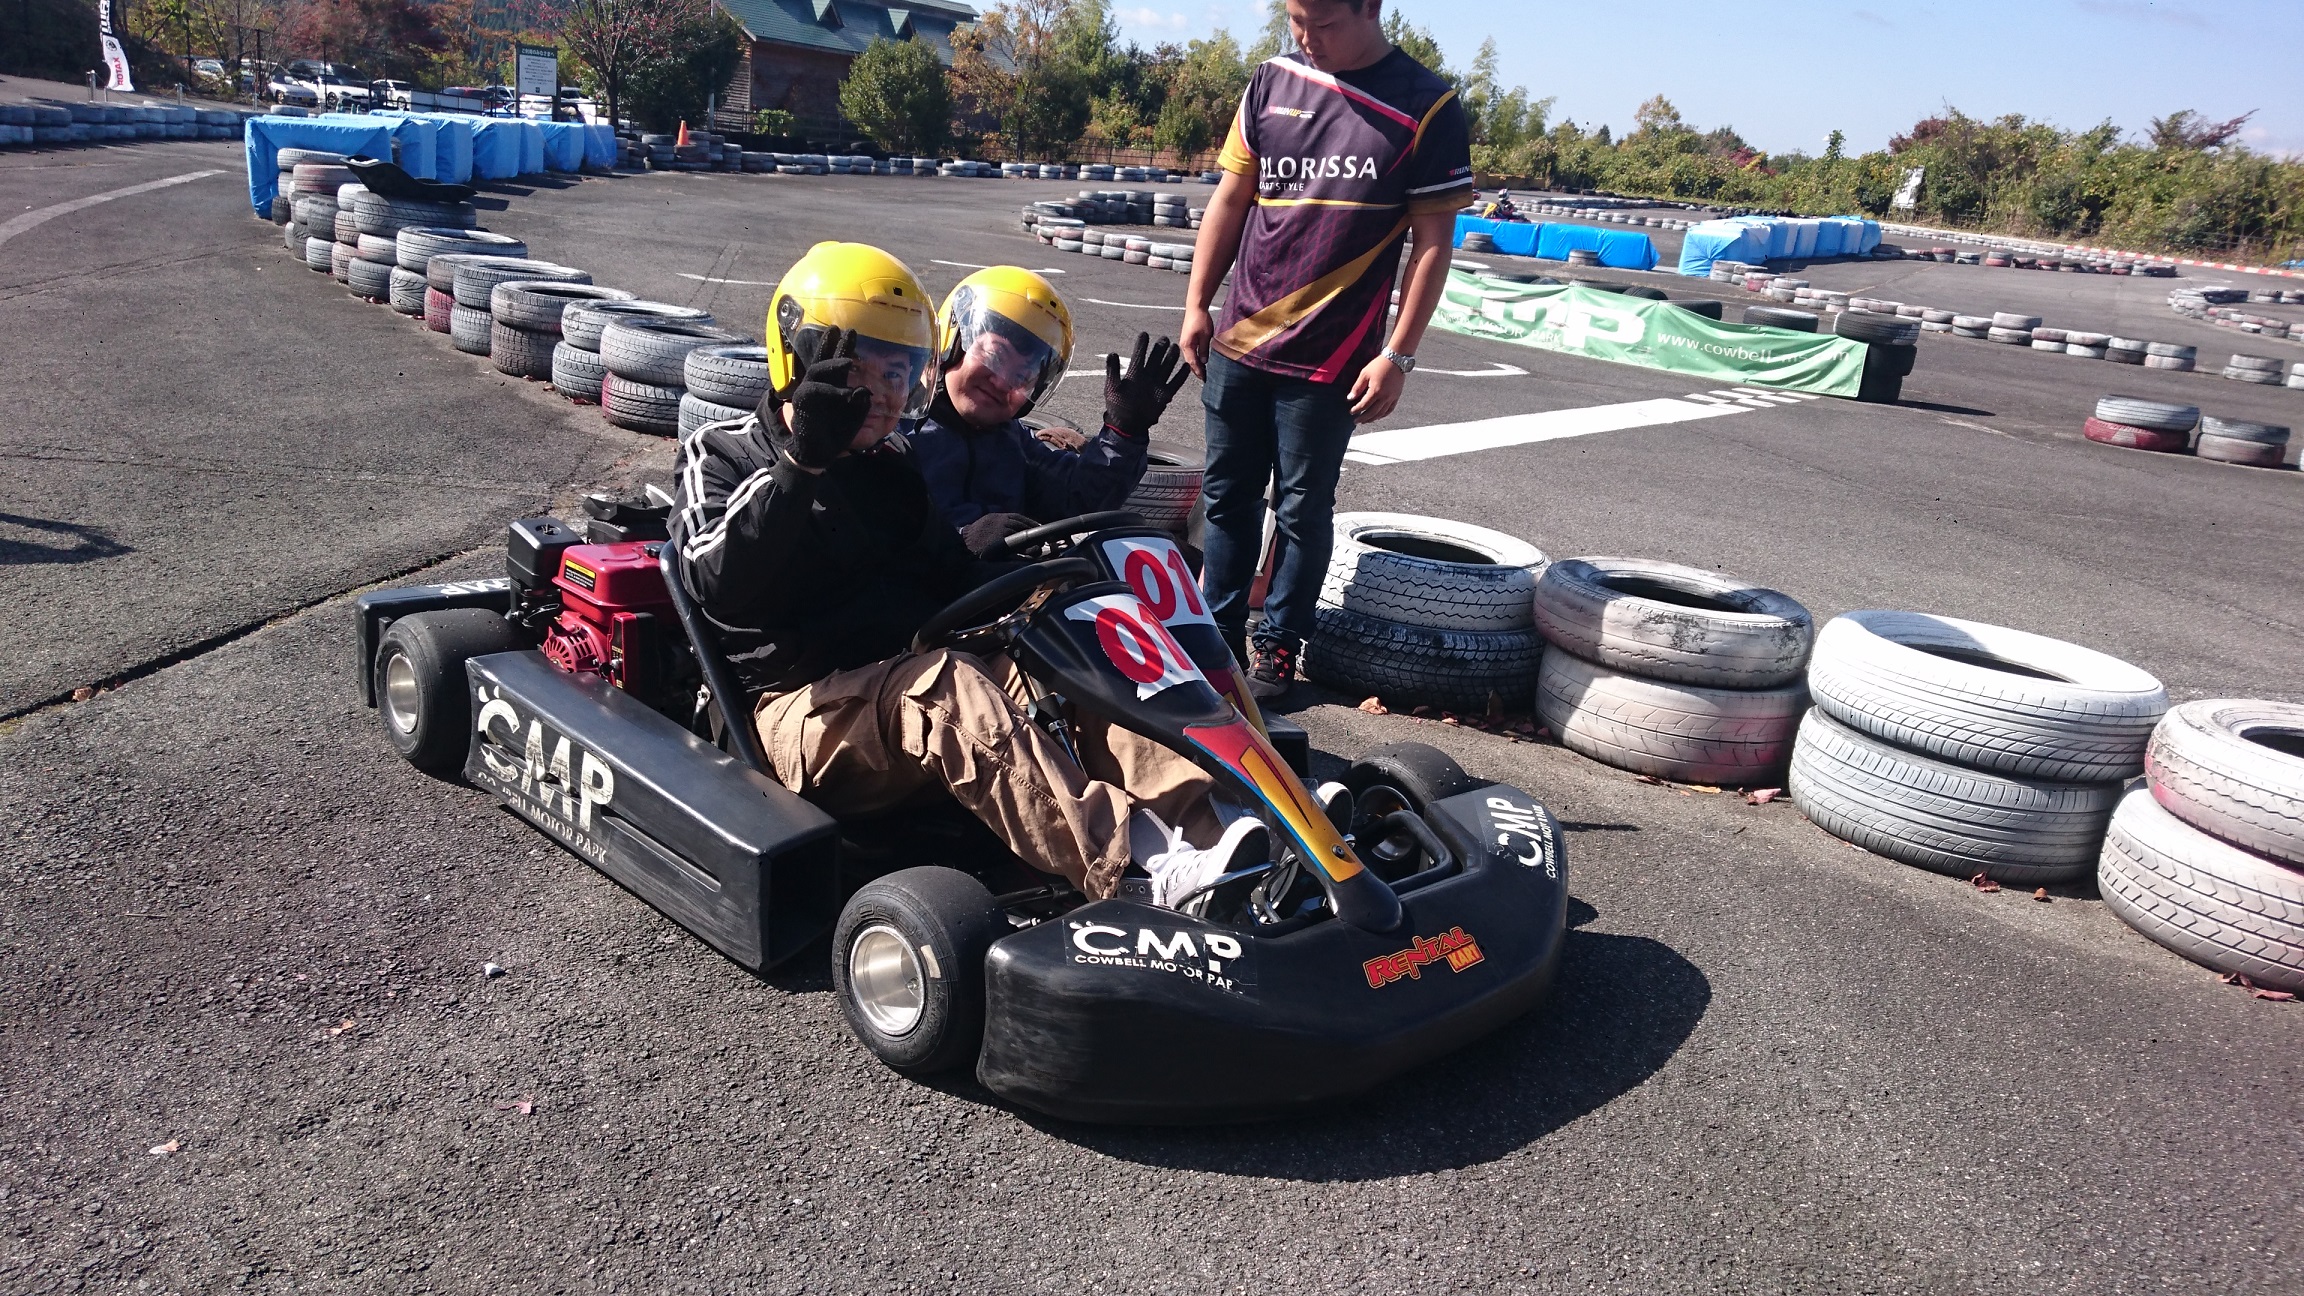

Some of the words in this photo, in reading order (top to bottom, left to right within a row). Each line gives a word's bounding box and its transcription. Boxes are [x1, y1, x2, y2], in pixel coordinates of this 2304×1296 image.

[113, 57, 124, 86] ROTAX
[1275, 182, 1305, 192] STYLE
[1124, 548, 1204, 622] 01
[1095, 602, 1194, 684] 01
[478, 699, 614, 832] CMP
[530, 804, 573, 841] MOTOR
[1486, 797, 1544, 867] CMP
[1072, 925, 1243, 974] CMP
[1074, 954, 1148, 968] COWBELL
[1150, 960, 1204, 980] MOOR
[1365, 927, 1474, 987] RENTAL
[1448, 943, 1480, 969] KART
